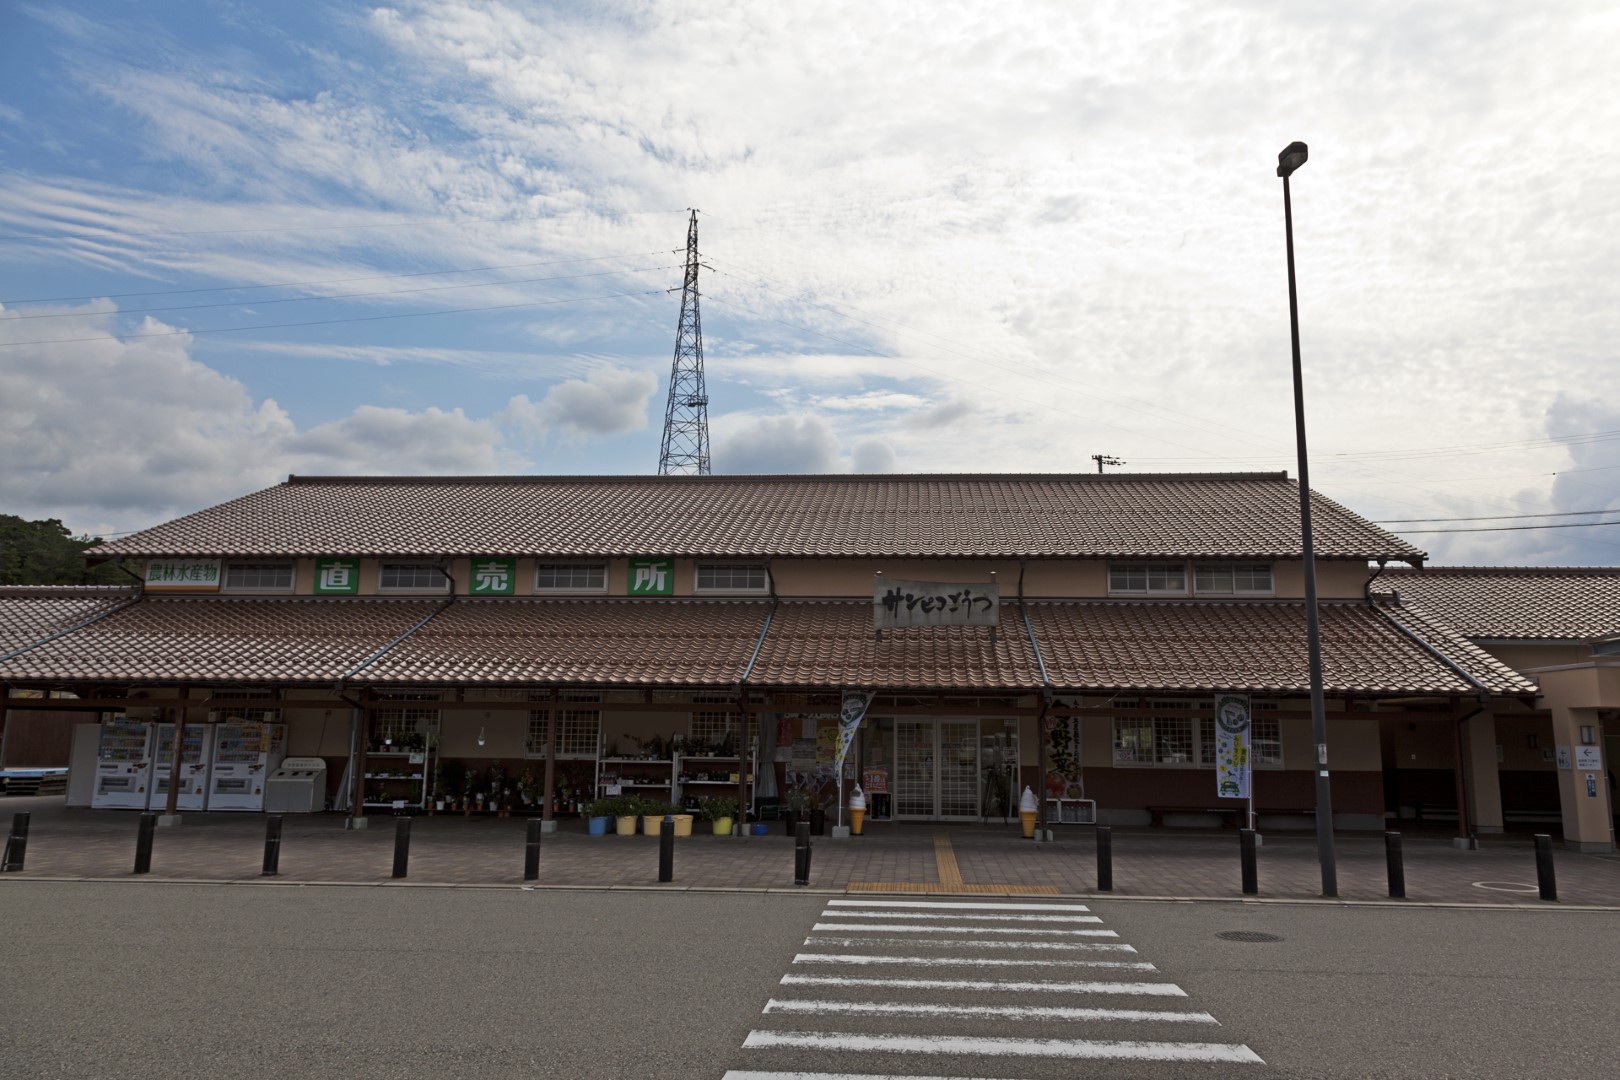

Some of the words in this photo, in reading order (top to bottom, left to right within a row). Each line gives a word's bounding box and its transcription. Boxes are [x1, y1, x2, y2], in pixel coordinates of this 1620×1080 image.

[148, 564, 217, 581] 農林水産物
[320, 562, 351, 590] 直
[475, 562, 508, 591] 売
[633, 562, 668, 592] 所
[882, 587, 993, 618] サンピコごうつ
